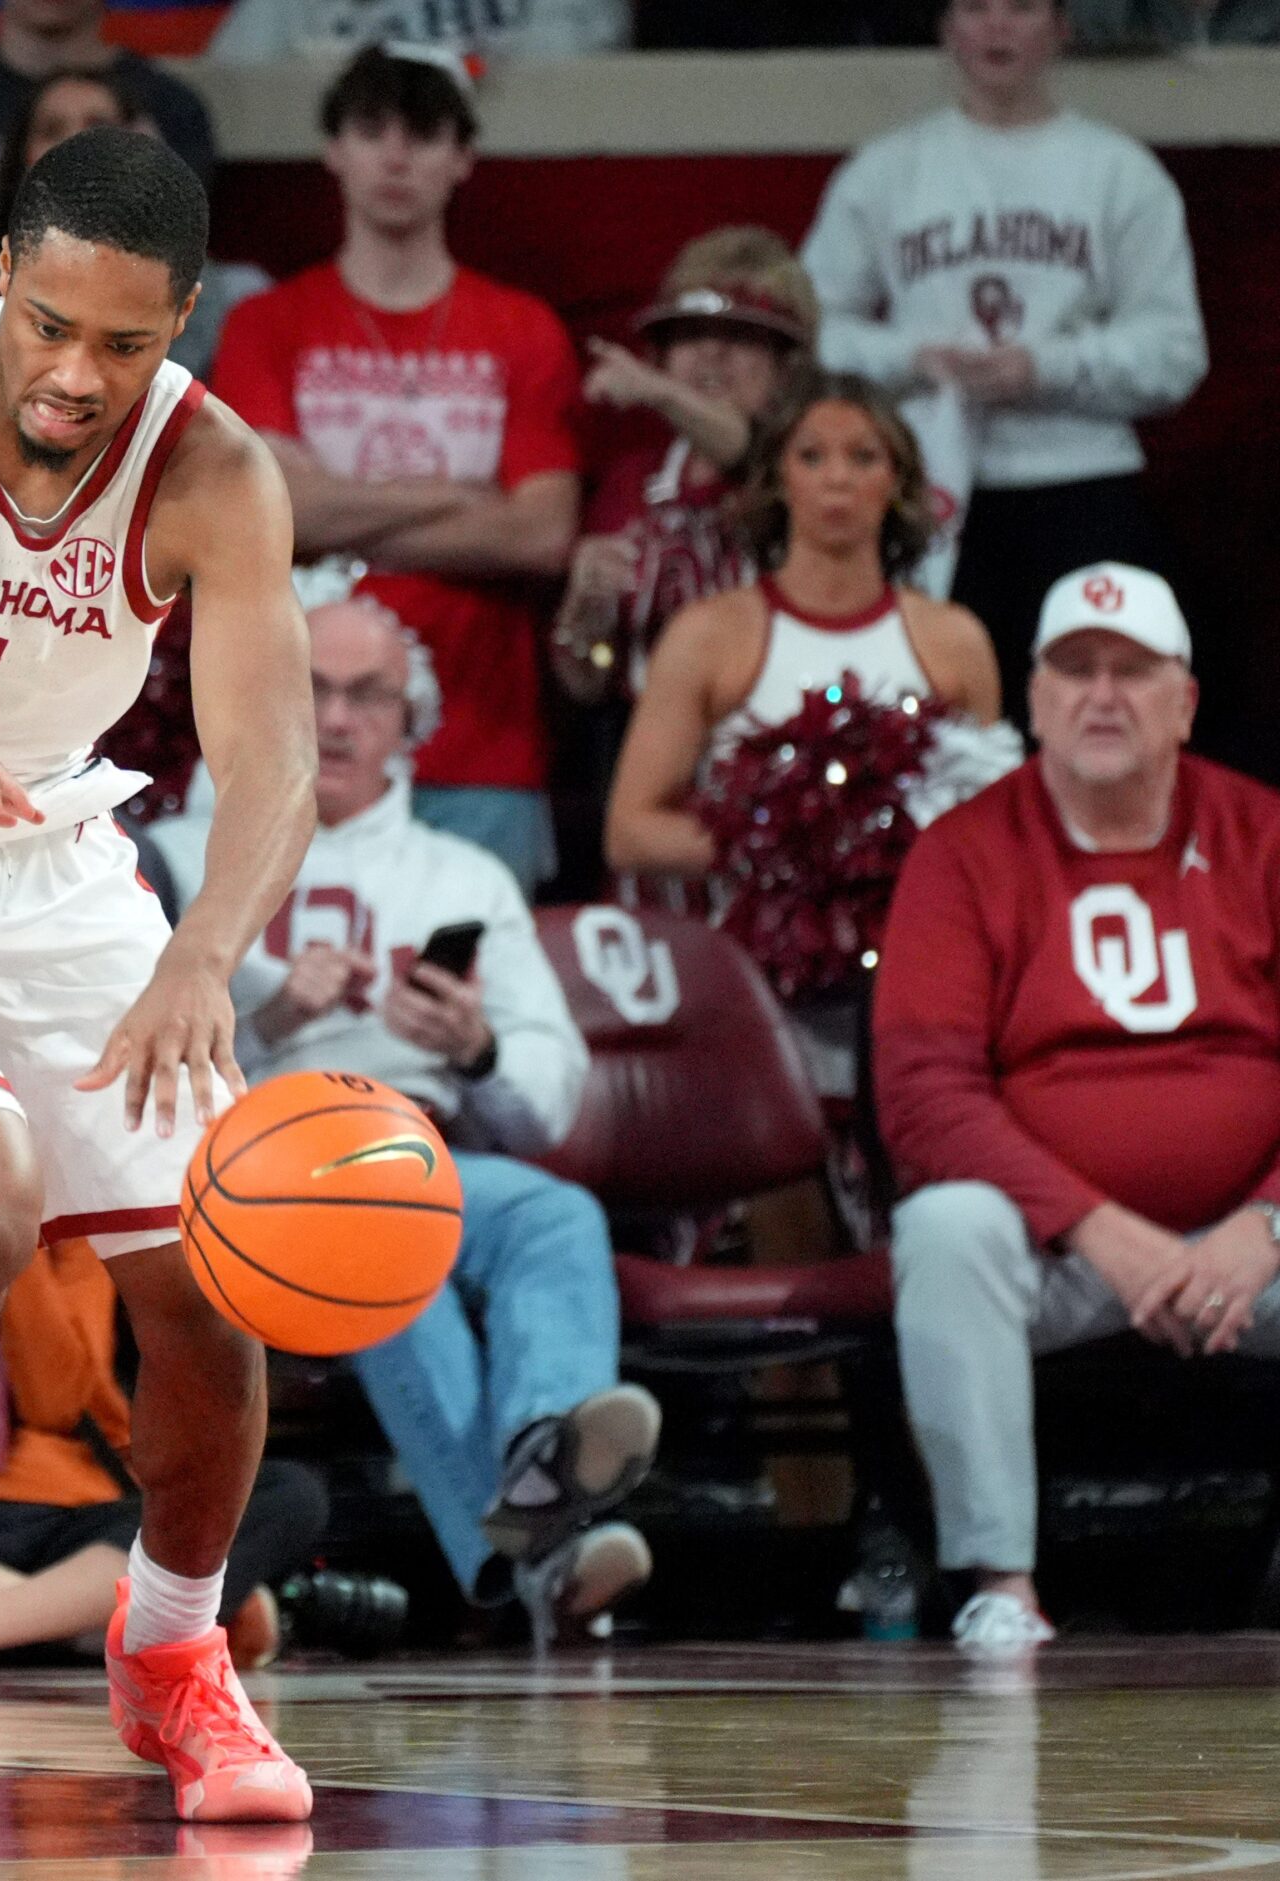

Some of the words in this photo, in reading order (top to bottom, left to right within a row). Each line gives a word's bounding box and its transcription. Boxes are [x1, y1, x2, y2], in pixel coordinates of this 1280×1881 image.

[898, 207, 1091, 284] OKLAHOMA
[52, 539, 115, 598] SEC
[1083, 575, 1125, 615] OU
[572, 905, 680, 1026] OU
[1070, 883, 1198, 1033] OU
